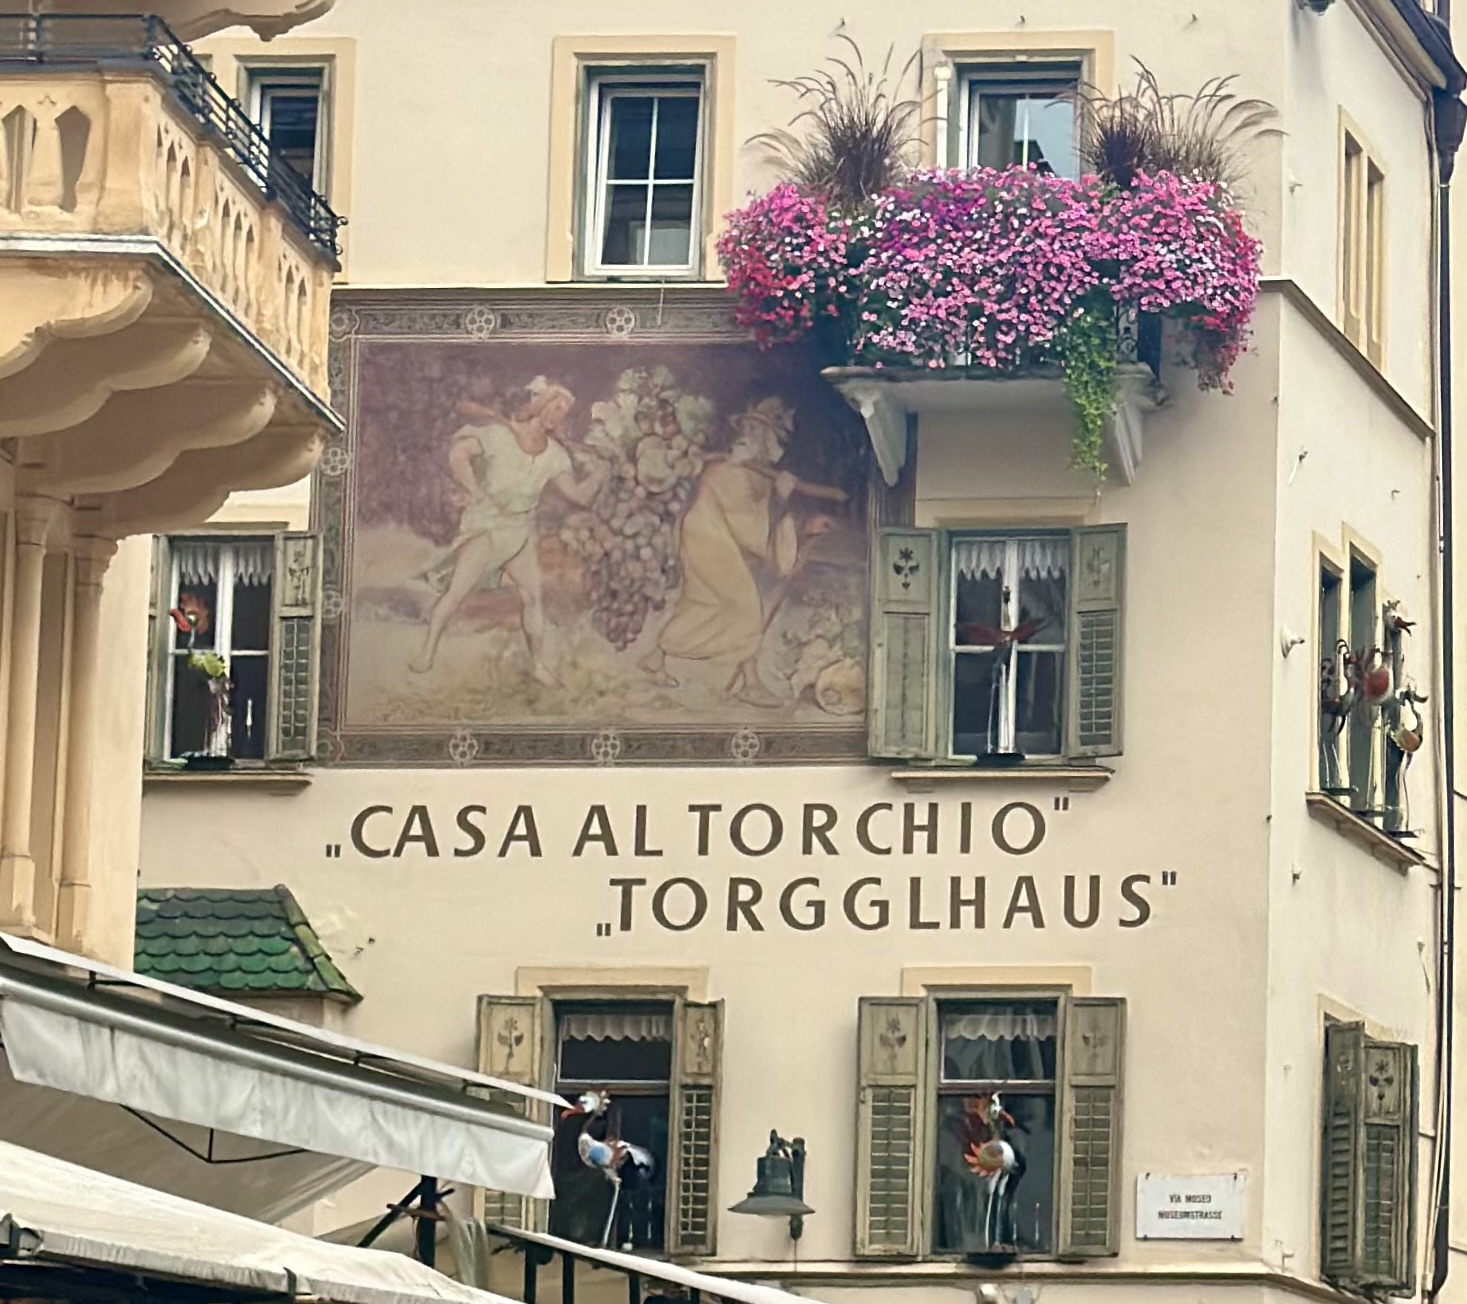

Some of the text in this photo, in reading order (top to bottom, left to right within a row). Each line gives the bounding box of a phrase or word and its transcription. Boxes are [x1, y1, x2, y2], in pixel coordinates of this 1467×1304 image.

[571, 803, 664, 858] AL
[1169, 1193, 1212, 1204] VIA MUSEO
[1158, 1209, 1222, 1221] MUSEUMSTRASSE
